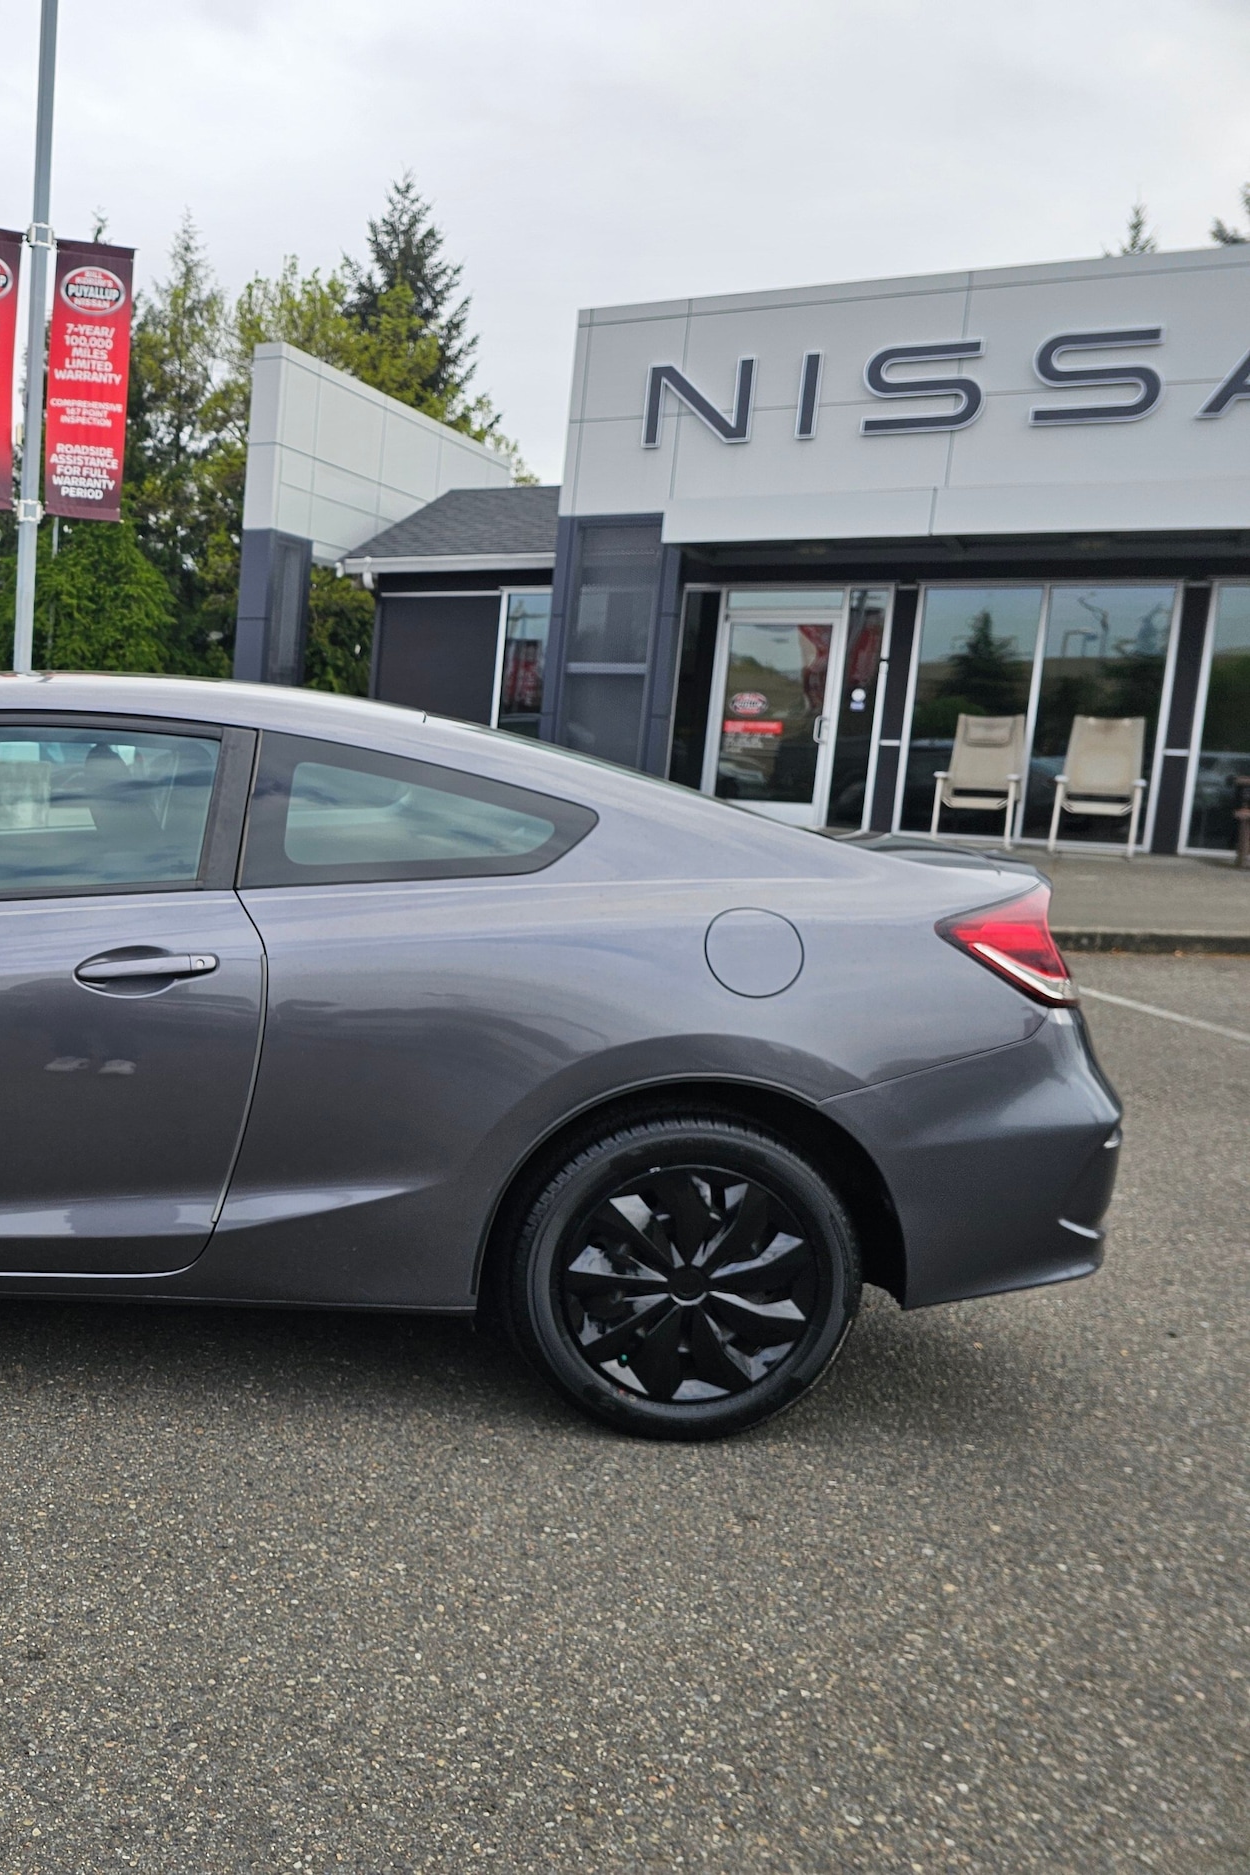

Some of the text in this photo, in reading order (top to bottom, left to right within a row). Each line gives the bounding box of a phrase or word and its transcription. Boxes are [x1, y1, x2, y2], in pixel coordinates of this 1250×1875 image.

[67, 283, 120, 302] PUYALLUP
[73, 297, 111, 309] NISSAN
[65, 323, 116, 339] 7-YEAR/
[71, 346, 109, 361] MILES
[64, 357, 114, 372] LIMITED
[53, 368, 123, 386] WARRANTY
[50, 397, 123, 413] COMPREHENSIVE
[60, 414, 112, 428] INSPECTION
[81, 408, 108, 419] POINT
[56, 443, 115, 459] ROADSIDE
[49, 453, 119, 470] ASSISTANCE
[56, 465, 110, 479] FOR FULL
[52, 474, 116, 491] WARRANTY
[60, 486, 104, 500] PERIOD
